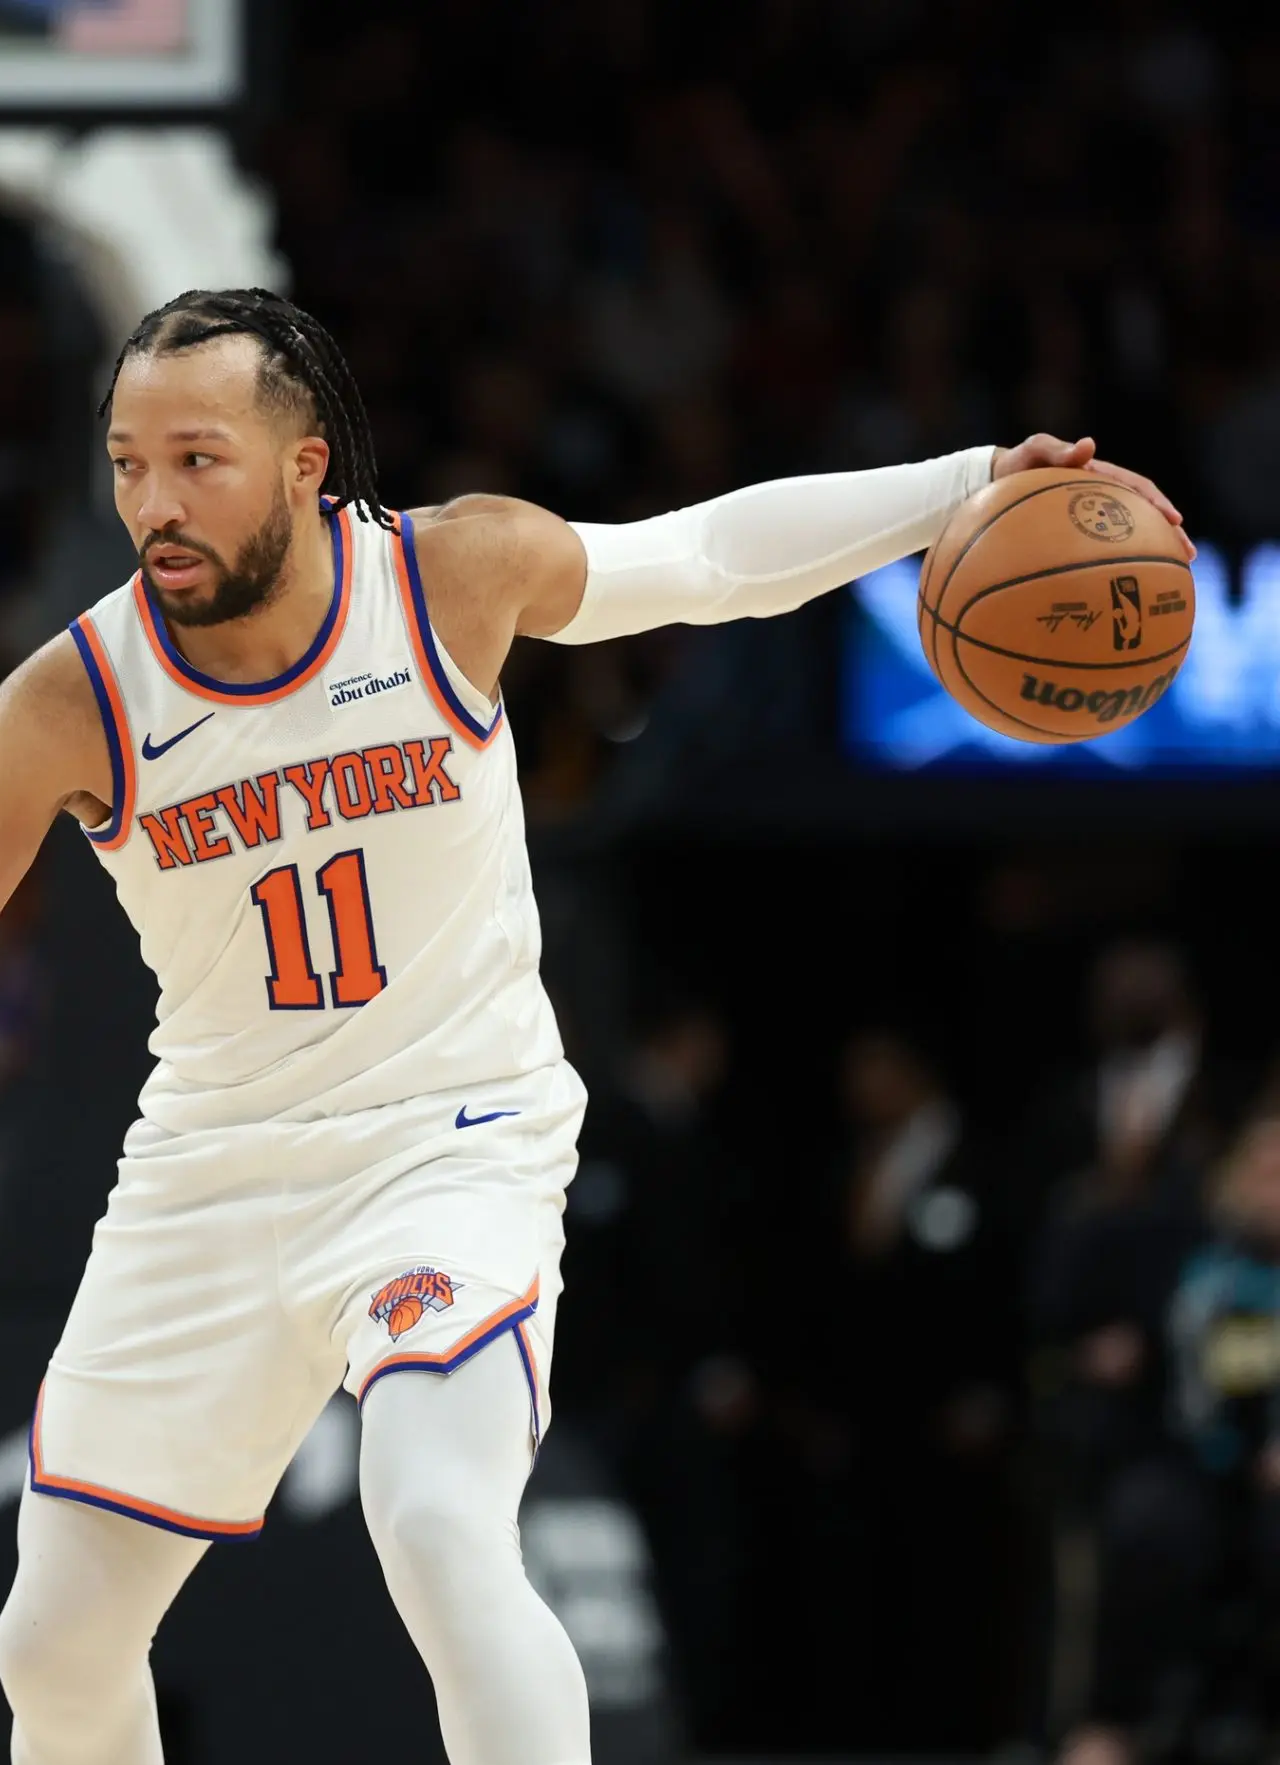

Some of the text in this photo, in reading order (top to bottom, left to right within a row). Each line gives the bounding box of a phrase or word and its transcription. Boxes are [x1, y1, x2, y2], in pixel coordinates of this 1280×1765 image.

[329, 673, 373, 690] experience
[331, 667, 412, 706] abu dhabi
[137, 734, 462, 872] NEW YORK
[250, 848, 387, 1010] 11
[368, 1272, 454, 1315] KNICKS
